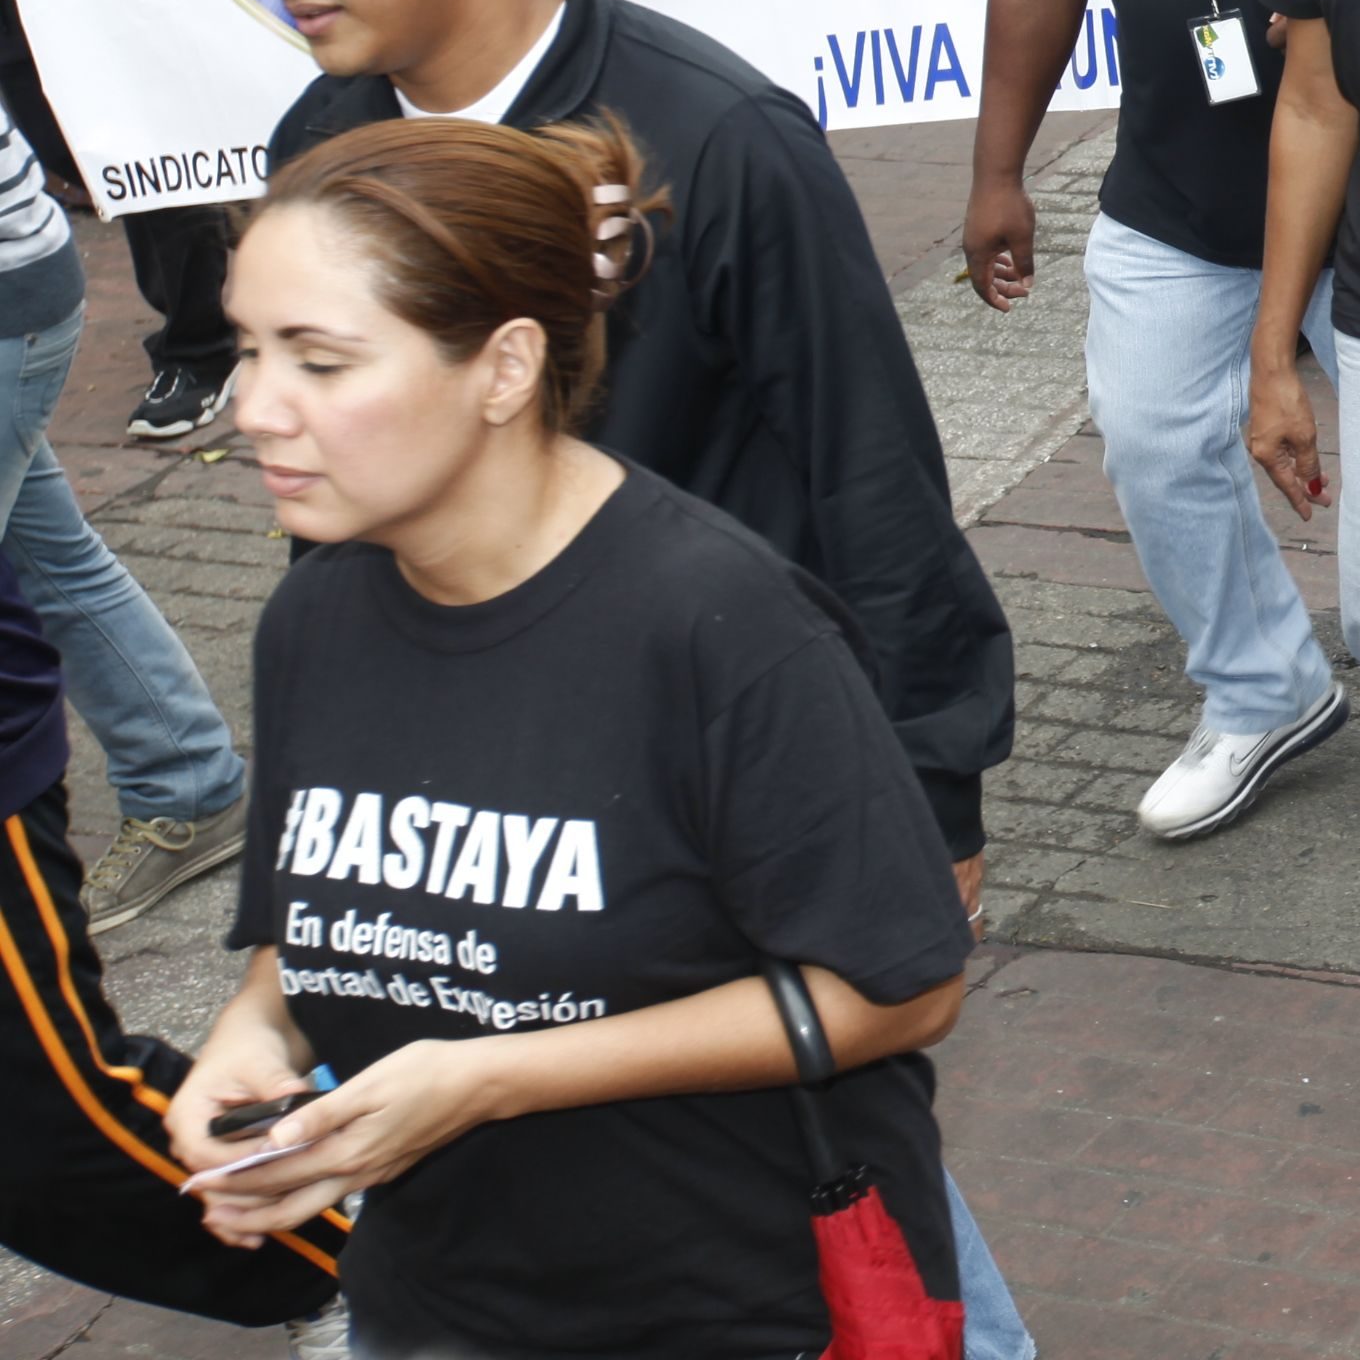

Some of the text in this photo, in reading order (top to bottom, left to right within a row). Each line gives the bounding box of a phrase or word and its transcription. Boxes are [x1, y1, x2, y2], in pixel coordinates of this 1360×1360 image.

[814, 22, 972, 130] ¡VIVA
[102, 144, 269, 201] SINDICATO
[286, 902, 496, 975] En defensa de
[386, 973, 431, 1008] de
[431, 976, 606, 1030] Expresión
